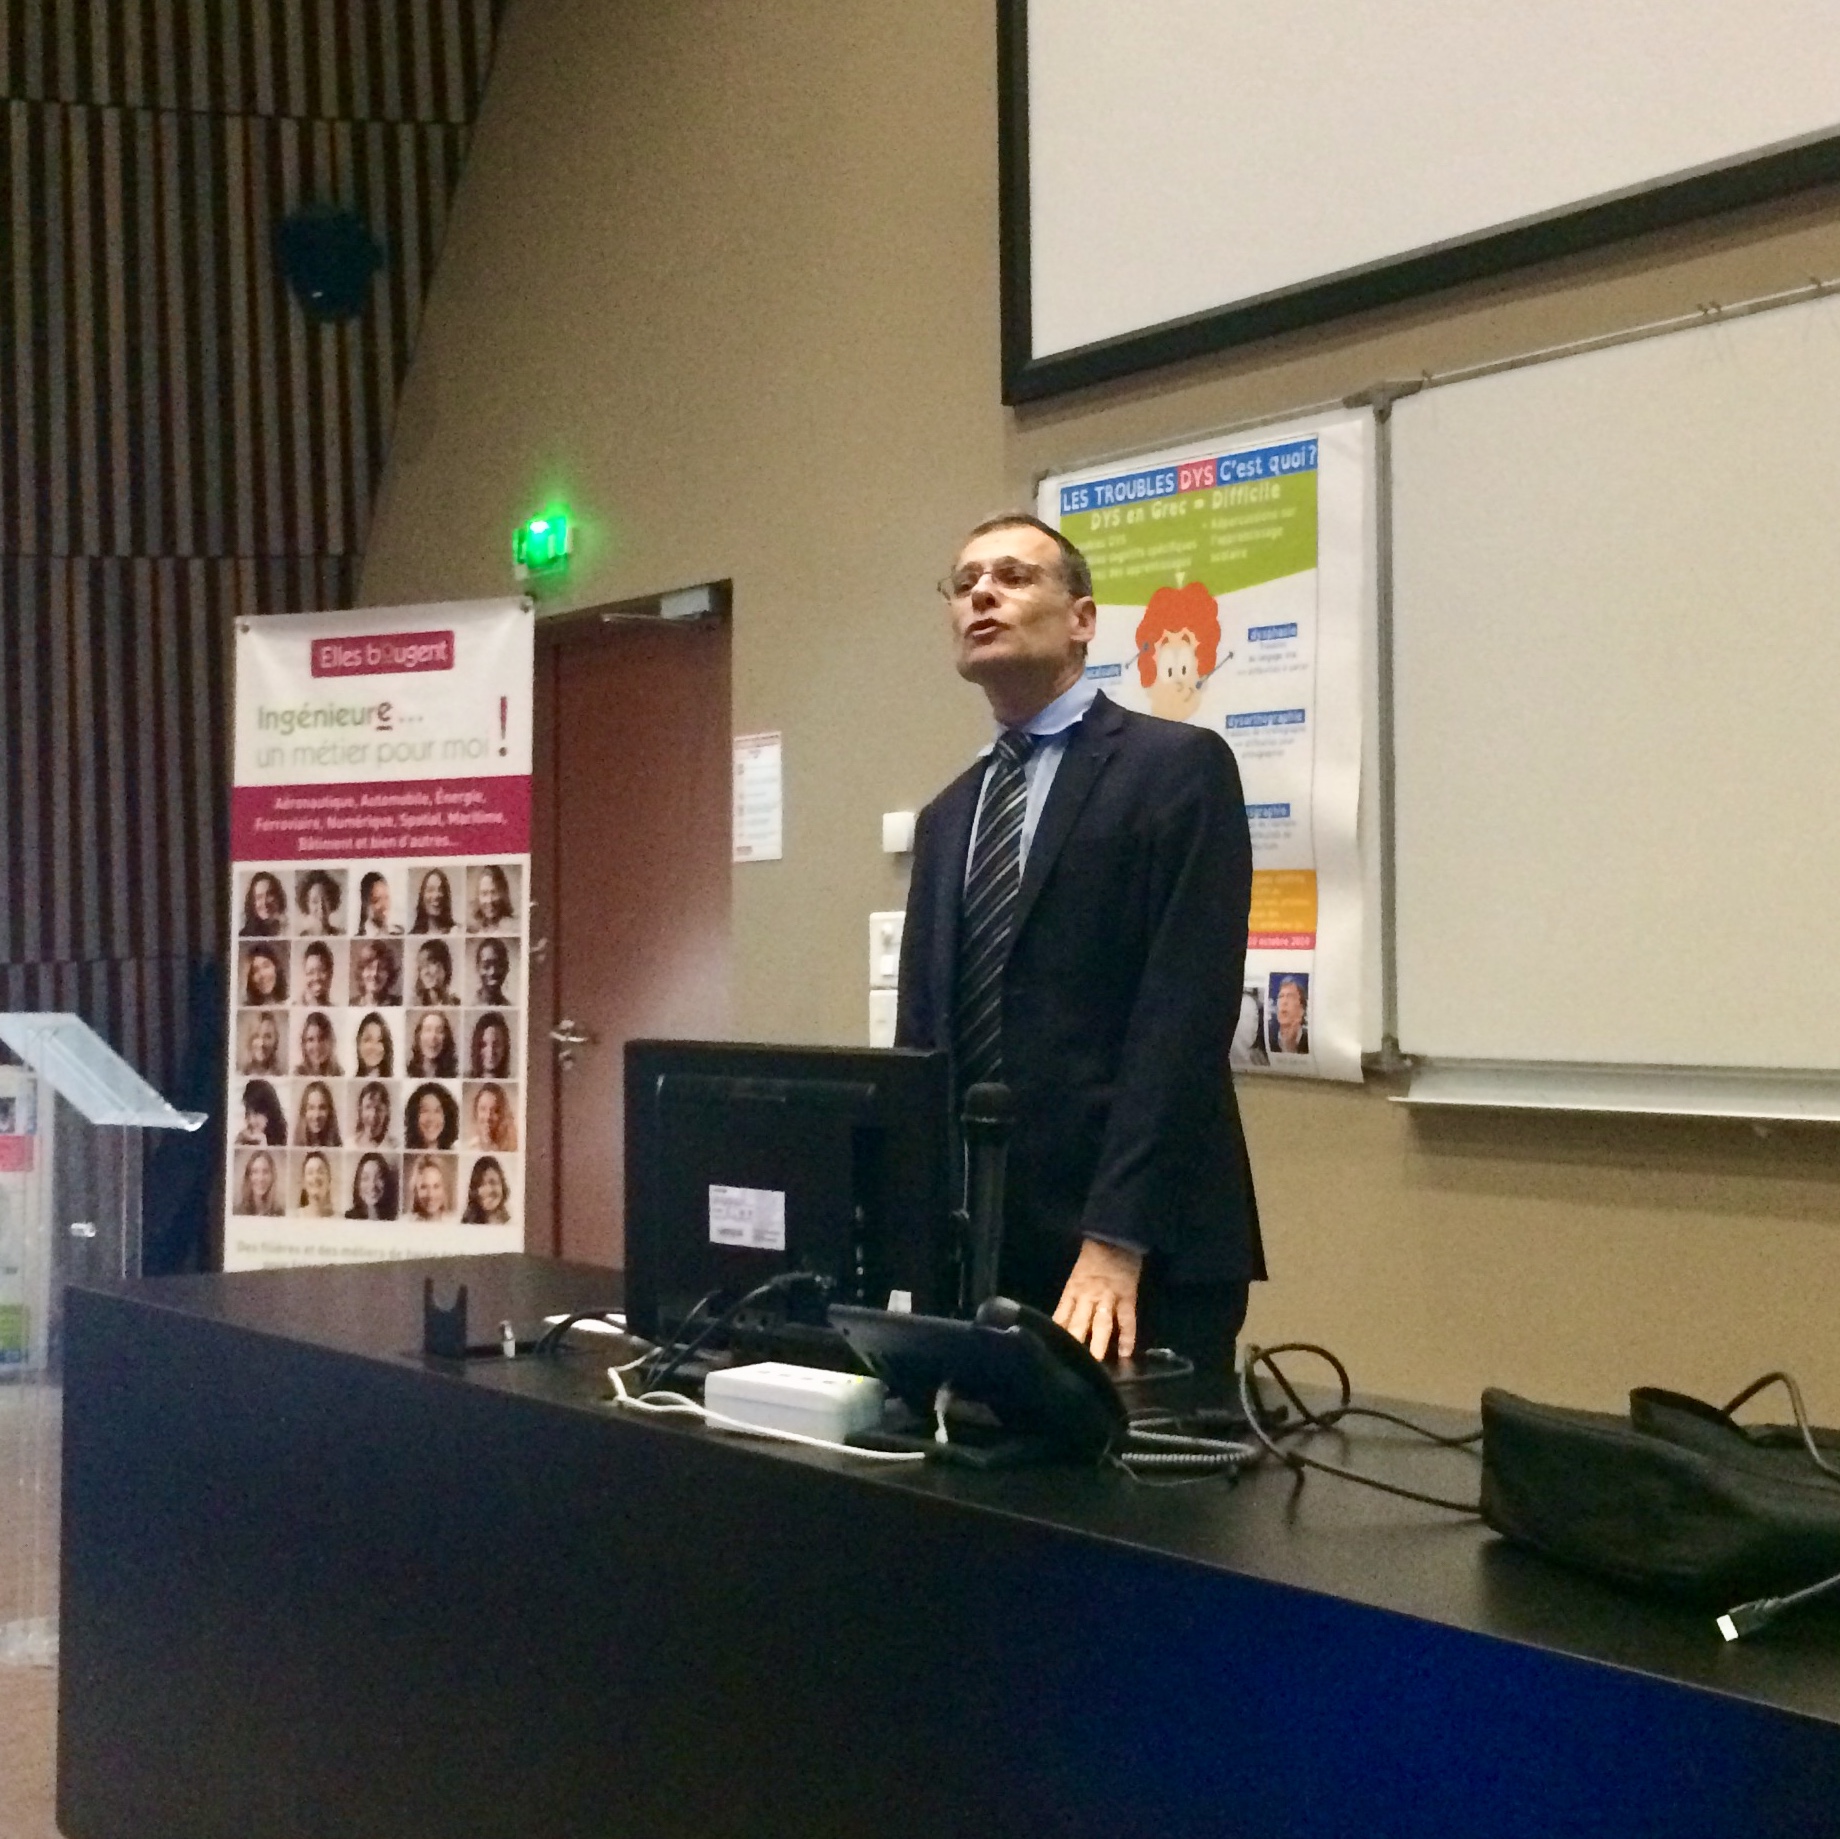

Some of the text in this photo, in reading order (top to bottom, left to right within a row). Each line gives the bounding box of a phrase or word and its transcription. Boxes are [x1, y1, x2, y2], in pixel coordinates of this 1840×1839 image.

[1063, 489, 1089, 512] LES
[1094, 473, 1175, 506] TROUBLES
[1180, 465, 1214, 490] DYS
[1220, 456, 1263, 481] C'est
[1090, 508, 1120, 531] DYS
[1127, 508, 1145, 525] en
[1151, 500, 1188, 520] Grec
[1212, 481, 1281, 510] Difficile
[320, 645, 362, 669] Elles
[257, 746, 285, 768] un
[293, 740, 371, 766] métier
[376, 740, 435, 768] pour
[441, 735, 489, 760] moi
